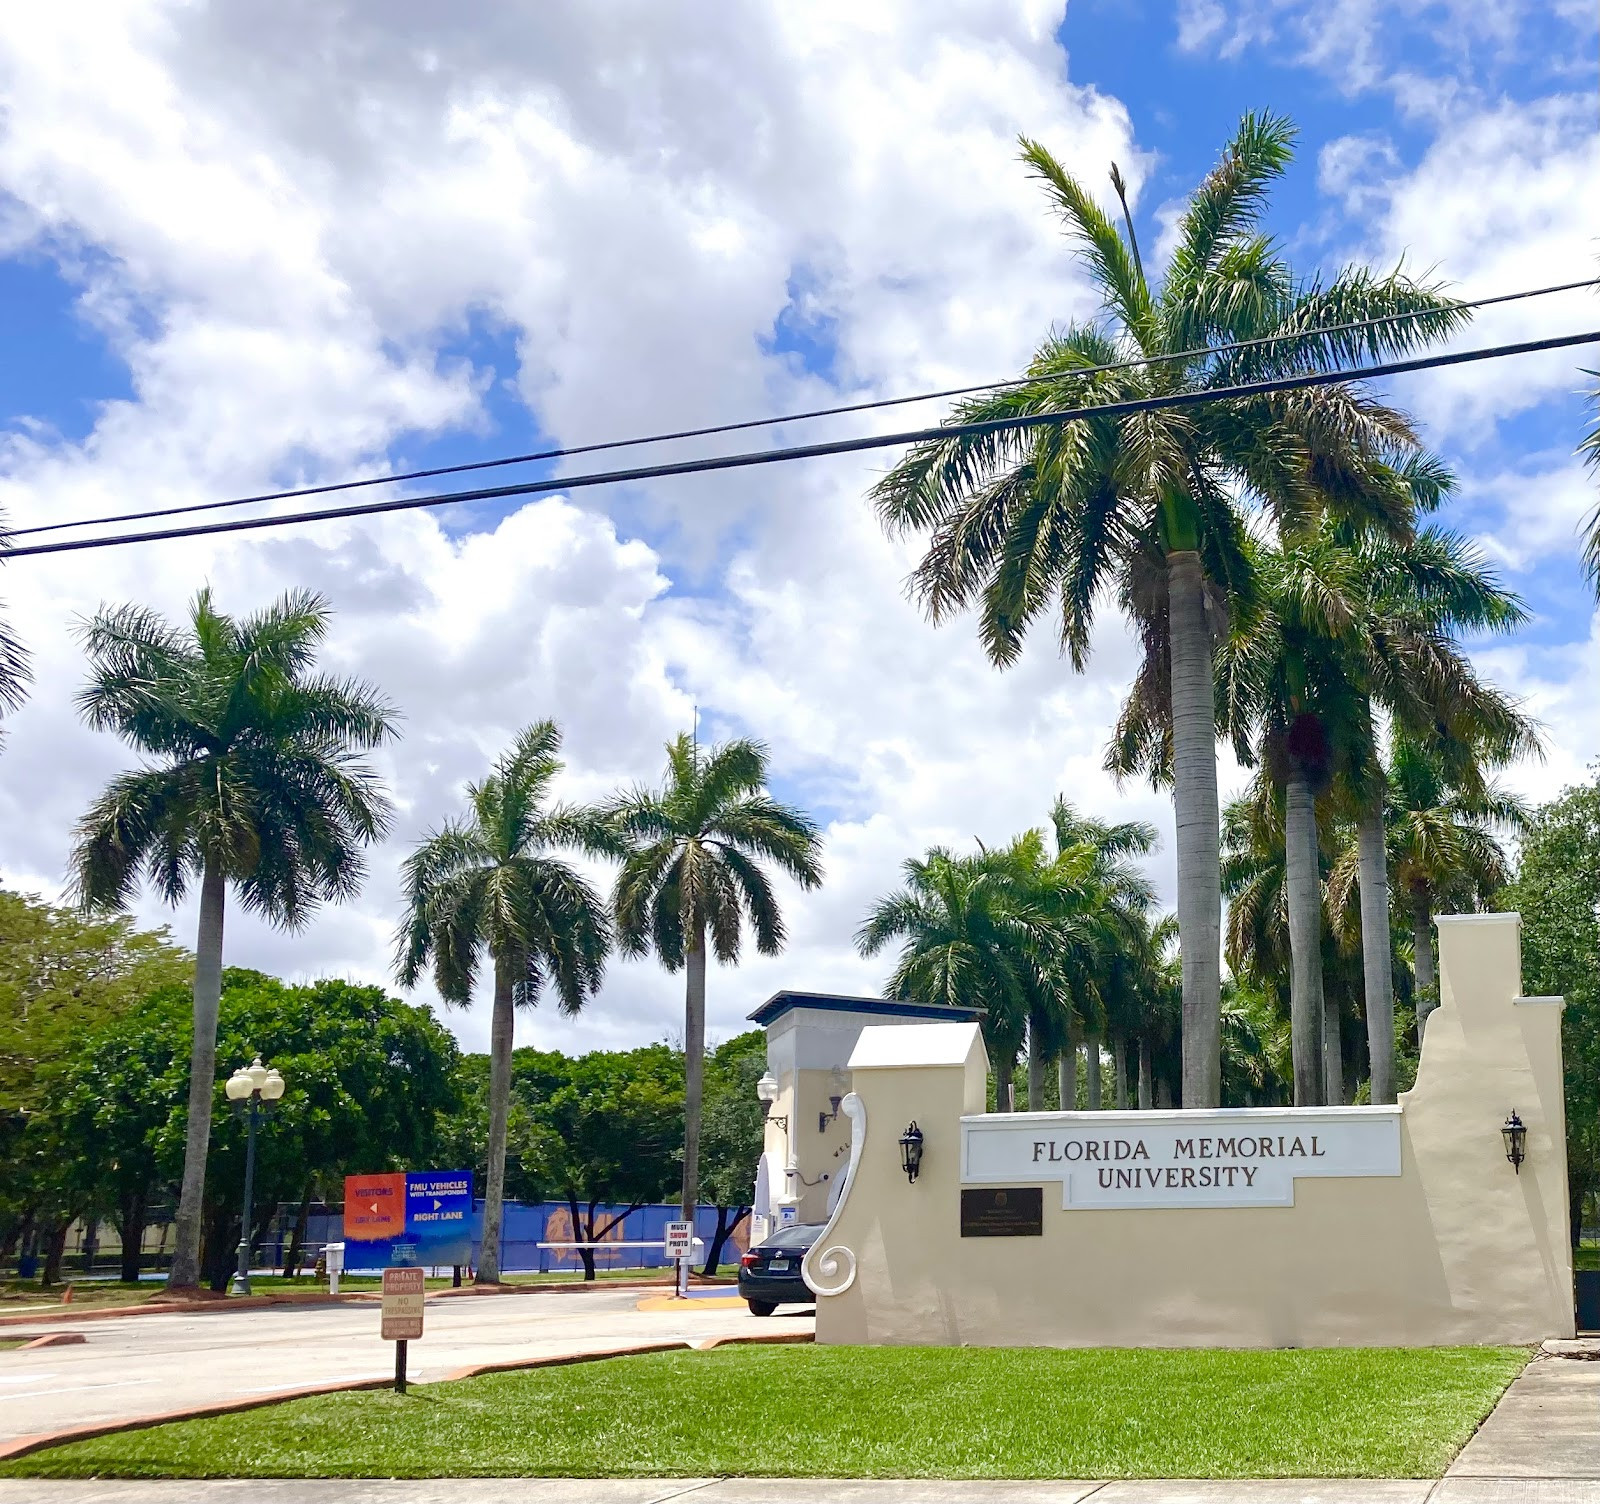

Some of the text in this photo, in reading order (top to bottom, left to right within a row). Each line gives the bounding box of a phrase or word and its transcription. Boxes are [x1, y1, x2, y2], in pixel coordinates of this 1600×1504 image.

[1032, 1136, 1326, 1162] FLORIDA MEMORIAL
[1098, 1166, 1259, 1189] UNIVERSITY
[409, 1181, 468, 1192] FMU VEHICLES
[355, 1187, 394, 1197] VISITORS
[425, 1189, 468, 1197] TRANSPONDER
[413, 1211, 464, 1221] RIGHT LANE
[389, 1272, 418, 1281] PRIVATE
[385, 1282, 421, 1291] PROPERTY
[397, 1297, 409, 1305] NO
[384, 1306, 422, 1315] TRESPASSING
